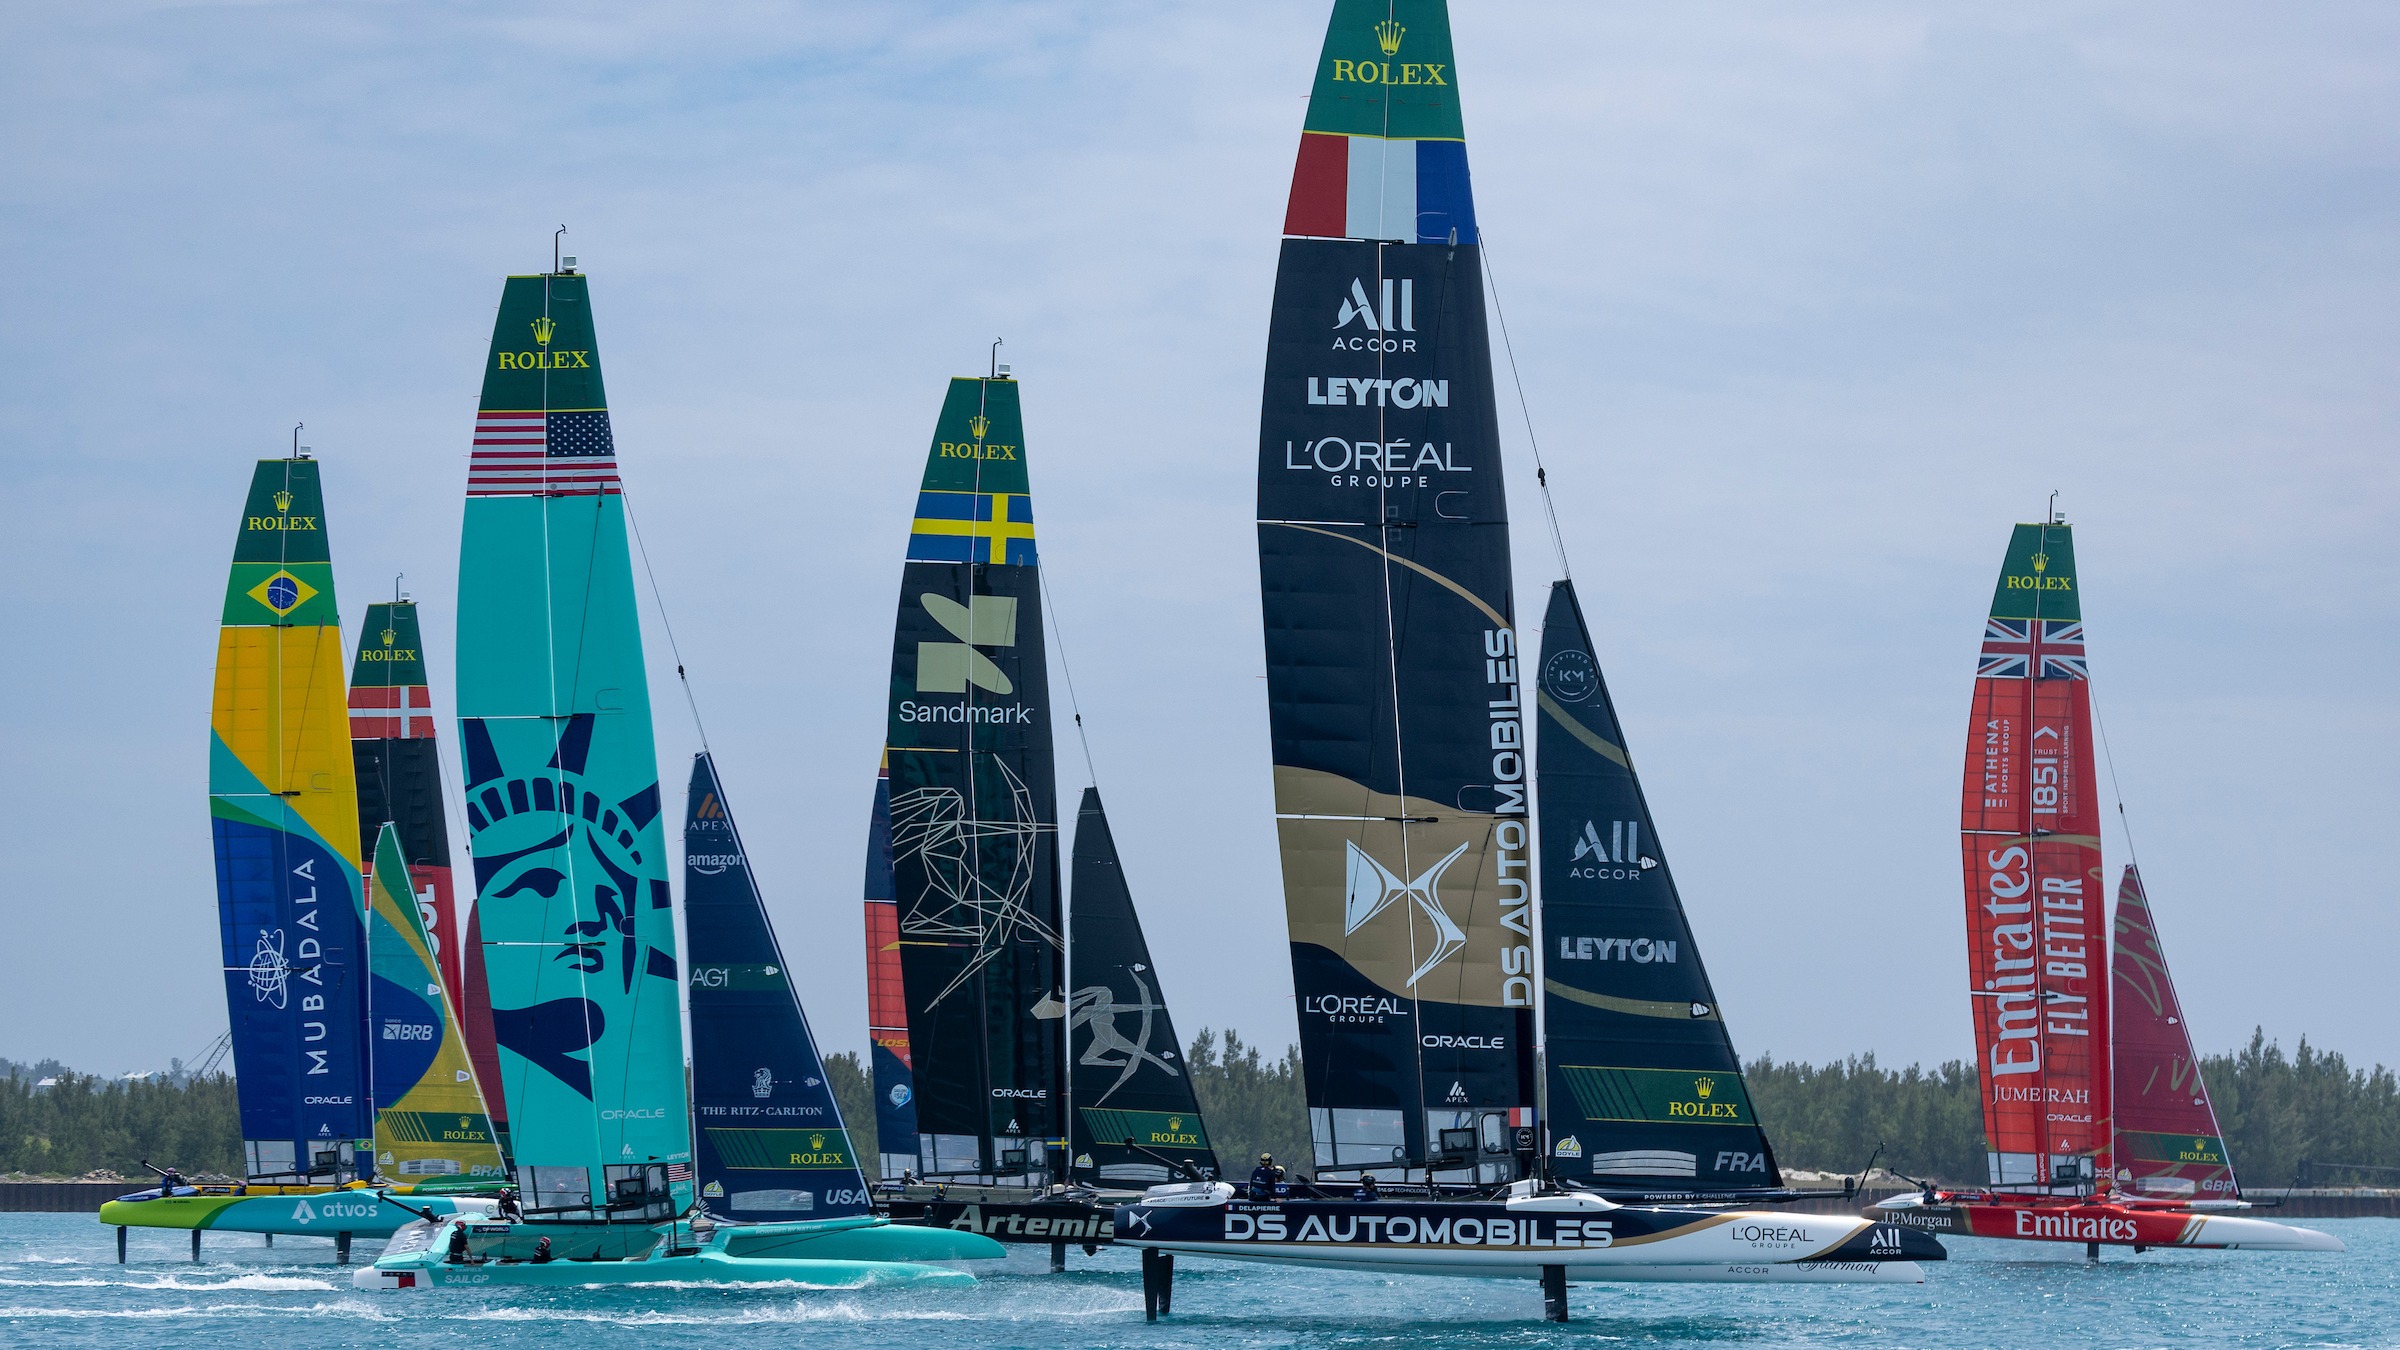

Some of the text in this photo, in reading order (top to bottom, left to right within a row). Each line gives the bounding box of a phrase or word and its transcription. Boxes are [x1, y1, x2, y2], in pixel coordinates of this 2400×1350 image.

[1333, 59, 1447, 85] ROLEX
[1332, 337, 1416, 352] ACCOR
[498, 351, 590, 369] ROLEX
[1307, 377, 1449, 409] LEYTON
[939, 442, 1016, 460] ROLEX
[1331, 475, 1428, 487] GROUPE
[248, 517, 317, 530] ROLEX
[2007, 575, 2072, 590] ROLEX
[361, 649, 416, 661] ROLEX
[1559, 670, 1584, 682] KM
[1985, 719, 1999, 793] ATHENA
[2001, 757, 2009, 793] SPORTS
[1484, 627, 1533, 1006] DS AUTOMOBILES
[690, 820, 731, 831] APEX
[687, 854, 744, 866] amazon
[1570, 868, 1640, 880] ACCOR
[1561, 936, 1676, 963] LEYTON
[2042, 877, 2089, 1036] FLY BETTER
[293, 858, 329, 1075] MUBADALA
[1984, 846, 2041, 1079] Emirates
[690, 968, 730, 987] AG1
[1329, 1015, 1384, 1023] GROUPE
[400, 1025, 433, 1040] BRB
[877, 1039, 910, 1047] LOS
[1422, 1035, 1505, 1049] ORACLE
[304, 1096, 352, 1104] ORACLE
[992, 1088, 1047, 1098] ORACLE
[1992, 1084, 2089, 1105] JUMEIRAH
[601, 1108, 665, 1120] ORACLE
[701, 1107, 823, 1116] THE RITZ-CARLTON
[1669, 1102, 1738, 1118] ROLEX
[2047, 1114, 2092, 1122] ORACLE
[443, 1131, 485, 1140] ROLEX
[1151, 1133, 1198, 1145] ROLEX
[790, 1153, 843, 1164] ROLEX
[1714, 1151, 1766, 1172] FRA
[2179, 1151, 2219, 1162] ROLEX
[469, 1165, 503, 1177] BRA
[2202, 1180, 2234, 1192] GBR
[825, 1189, 866, 1205] USA
[323, 1202, 378, 1217] atvos
[950, 1204, 1115, 1239] Artemis
[2015, 1210, 2138, 1240] Emirates
[1225, 1213, 1614, 1247] DS AUTOMOBILES
[1728, 1266, 1769, 1274] ACCOR
